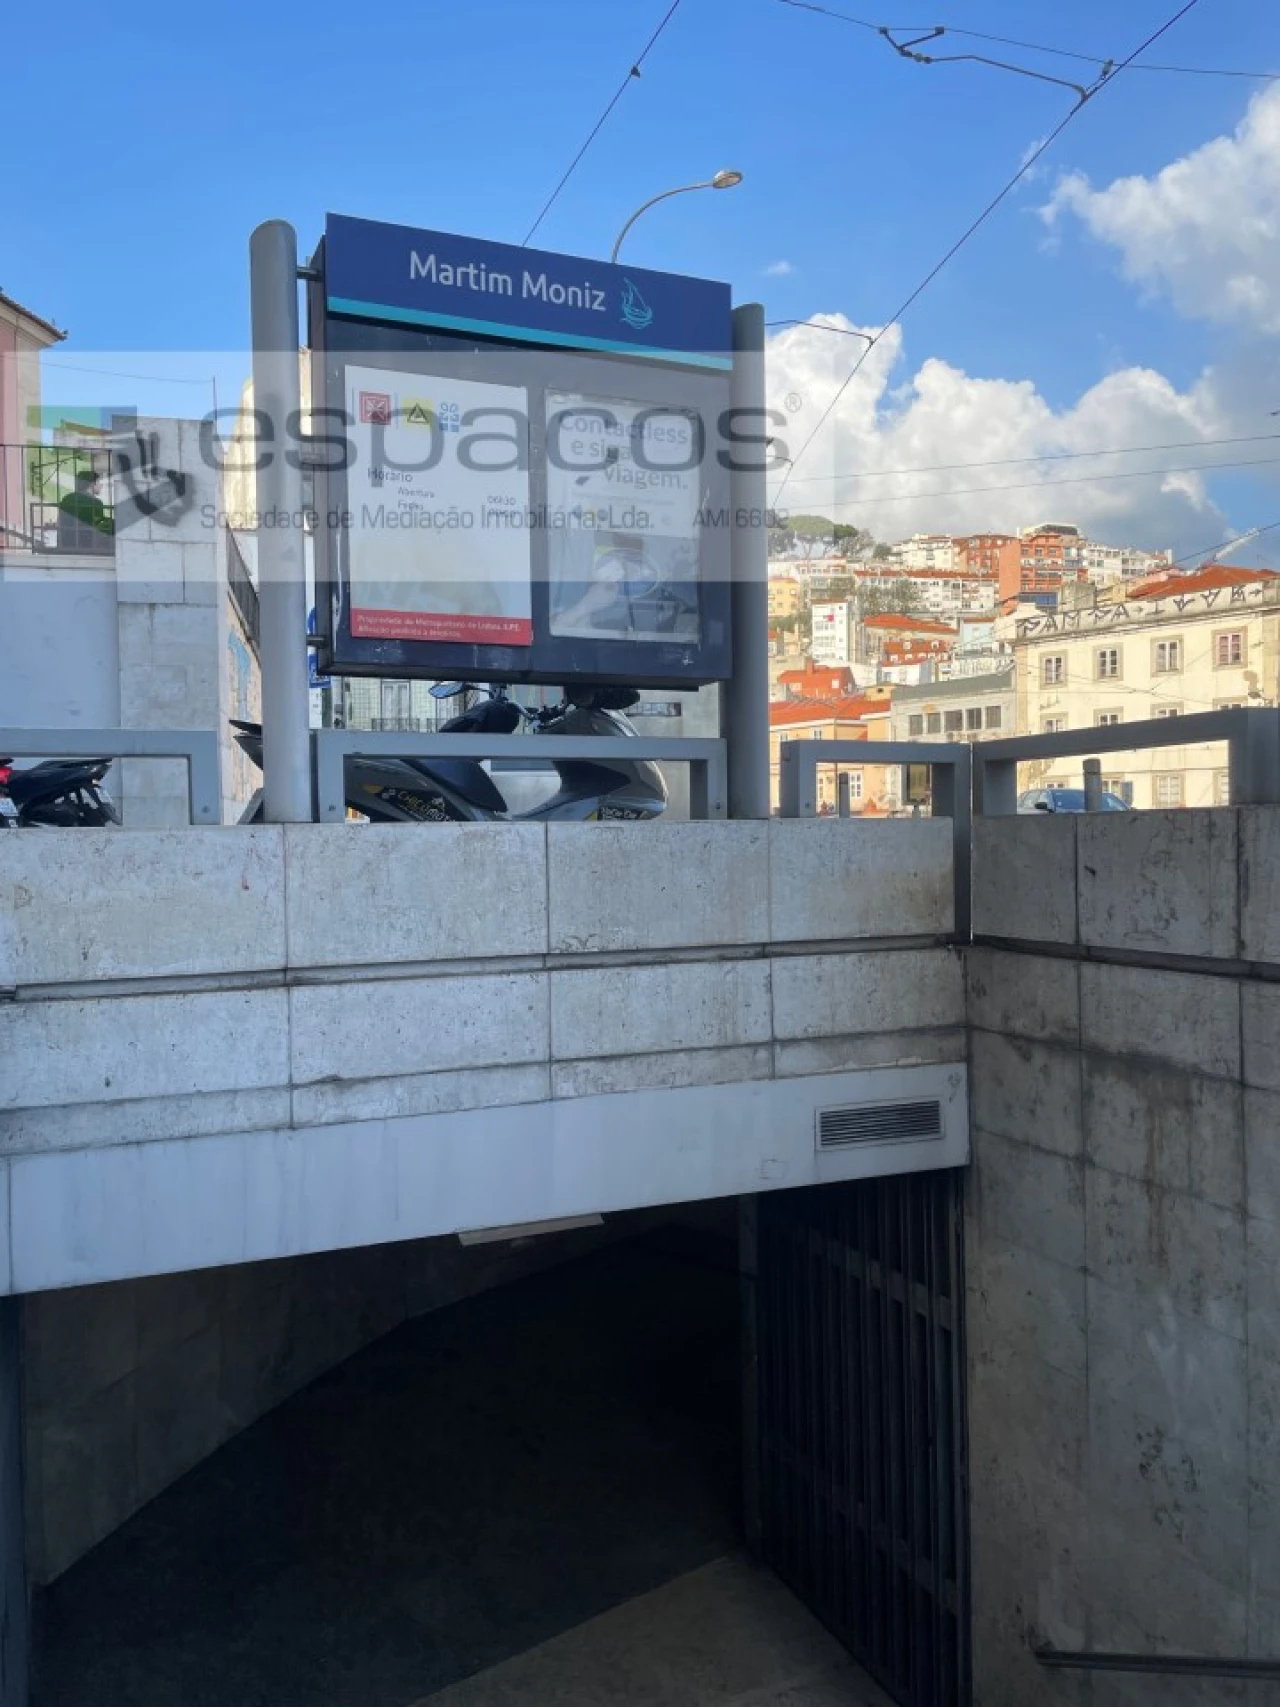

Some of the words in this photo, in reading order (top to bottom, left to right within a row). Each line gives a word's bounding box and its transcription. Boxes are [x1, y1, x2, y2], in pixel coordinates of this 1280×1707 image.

[410, 250, 513, 296] Martim
[522, 269, 607, 312] Moniz
[570, 439, 584, 456] e
[603, 463, 689, 490] viagem.
